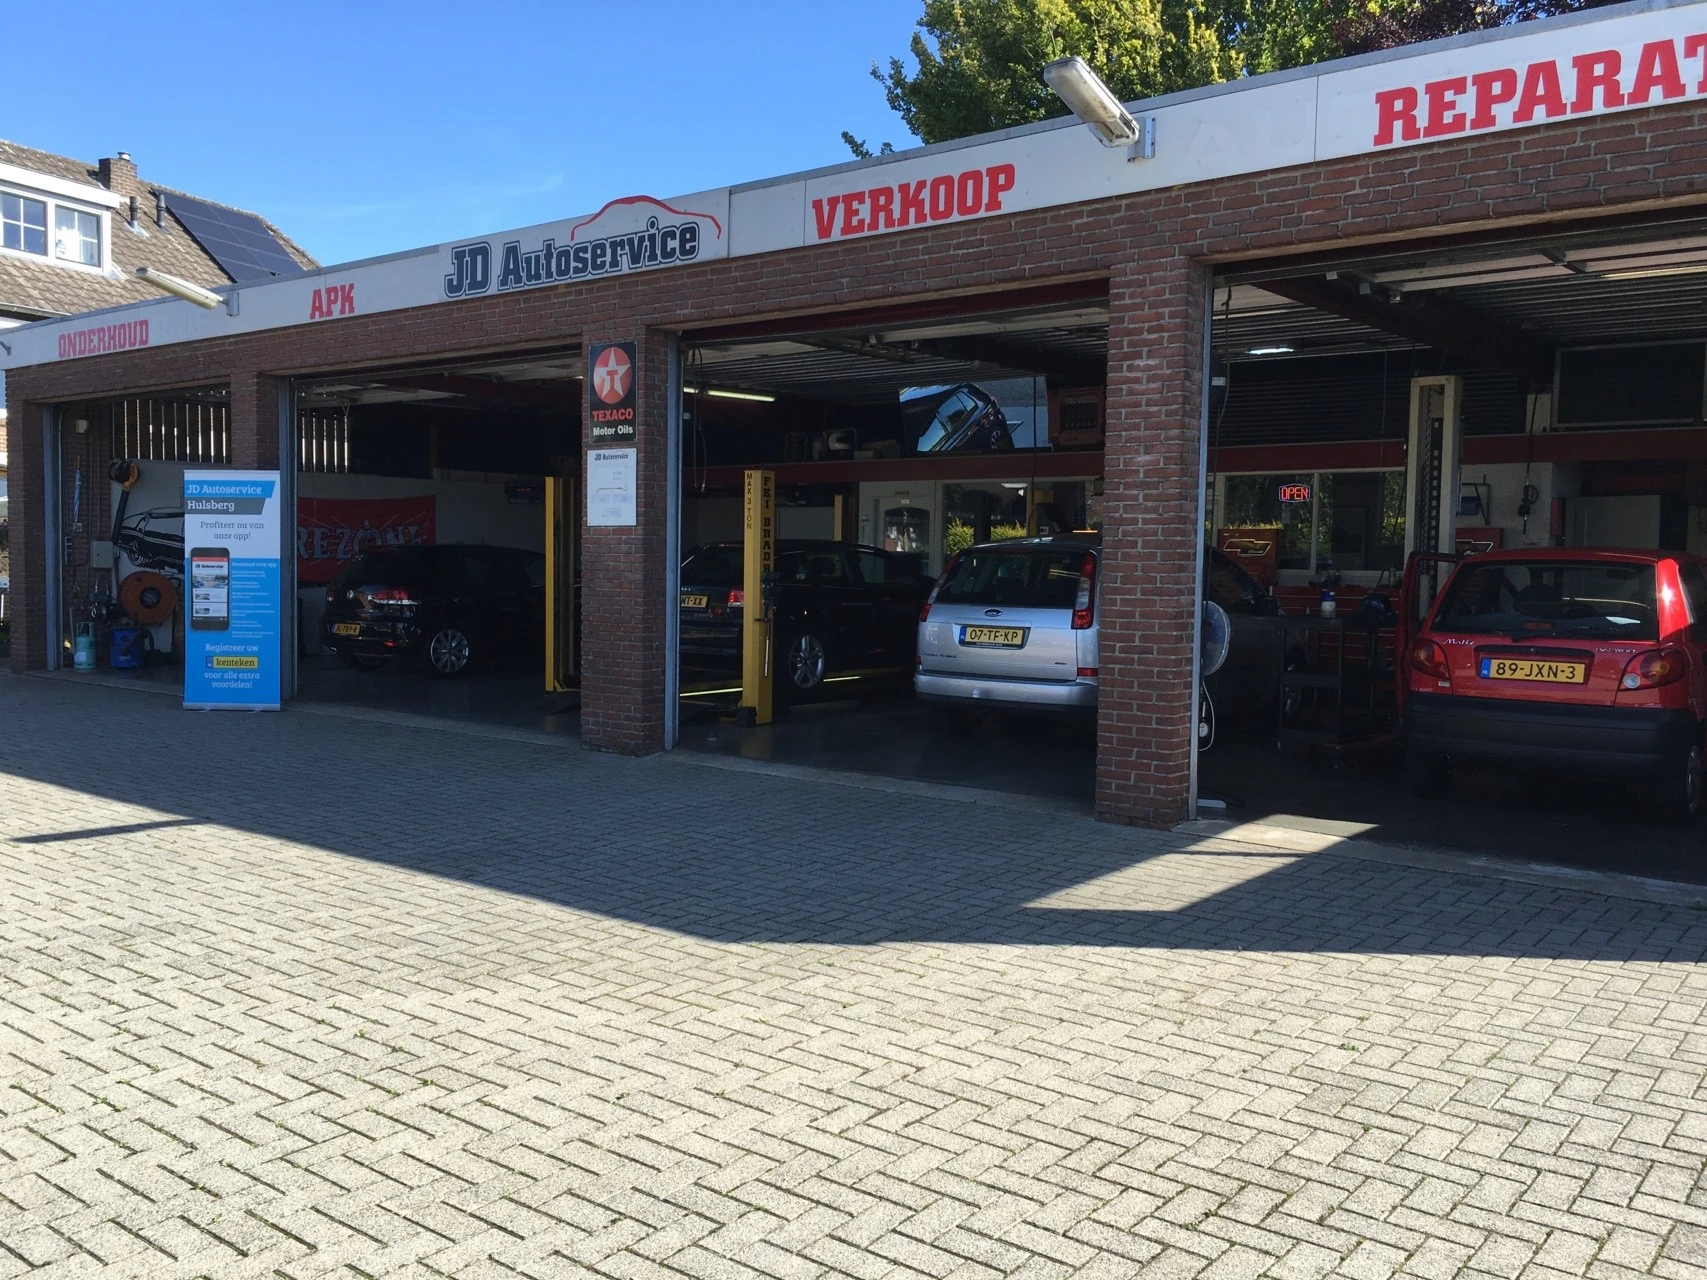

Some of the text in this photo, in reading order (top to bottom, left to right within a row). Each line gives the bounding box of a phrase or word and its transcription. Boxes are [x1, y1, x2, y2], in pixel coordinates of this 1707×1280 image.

[811, 163, 1016, 240] VERKOOP
[444, 215, 701, 298] JD Autoservice
[309, 283, 356, 320] APK
[58, 319, 149, 359] ONDERHOUD
[592, 407, 634, 422] TEXACO
[593, 424, 634, 436] Motor Oils
[186, 484, 262, 494] JD Autoservice
[1281, 487, 1309, 500] OPEN
[187, 500, 235, 511] Hulsberg
[747, 497, 753, 505] 3
[200, 520, 235, 529] Profiteer
[213, 532, 251, 541] onze app!
[970, 629, 1018, 642] 07-TF-KP
[205, 644, 245, 652] Registreer
[216, 658, 255, 667] kenteken
[223, 671, 238, 679] alle
[1496, 662, 1576, 680] 89-JXN-3
[211, 681, 253, 689] voordelen!
